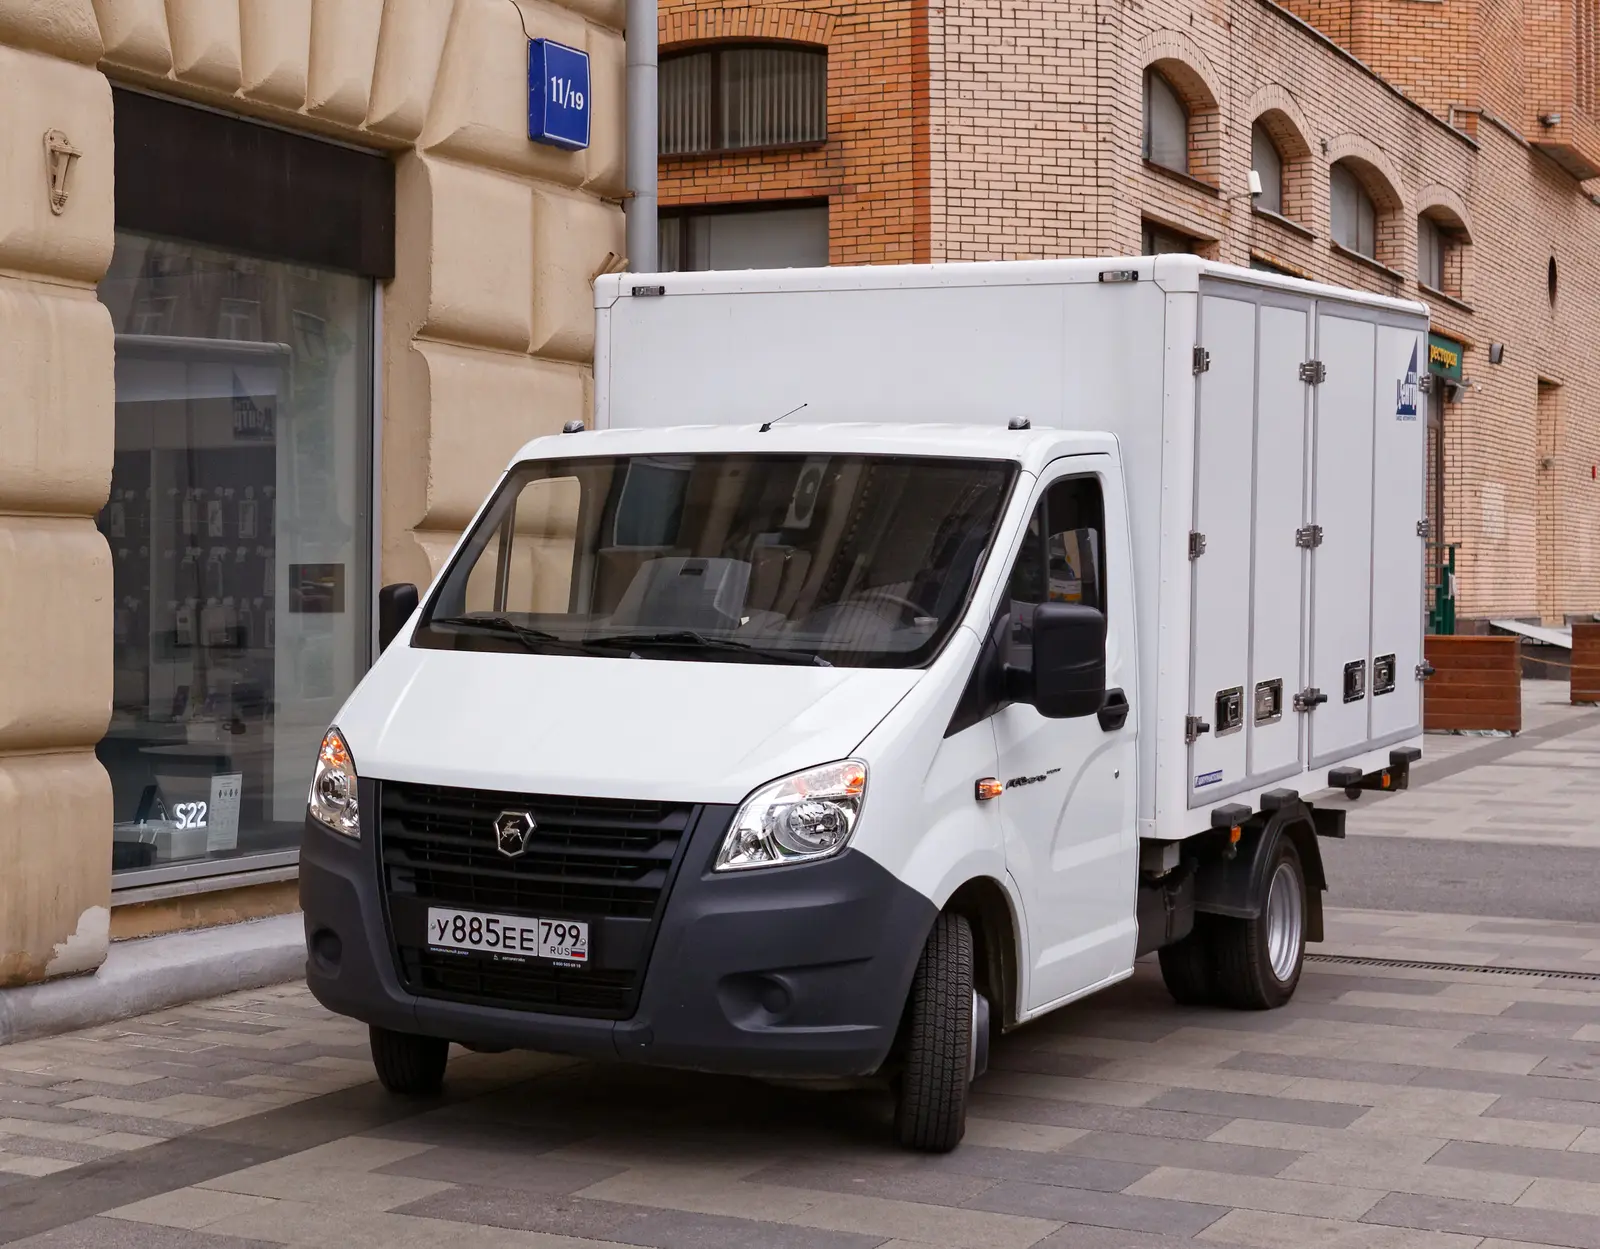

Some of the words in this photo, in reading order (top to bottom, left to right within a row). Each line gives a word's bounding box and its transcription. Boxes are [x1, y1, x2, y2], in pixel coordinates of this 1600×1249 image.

[551, 76, 584, 110] 11/19
[1430, 344, 1458, 369] ресторан
[174, 801, 207, 830] S22
[541, 922, 581, 946] 799
[550, 946, 570, 956] RUS
